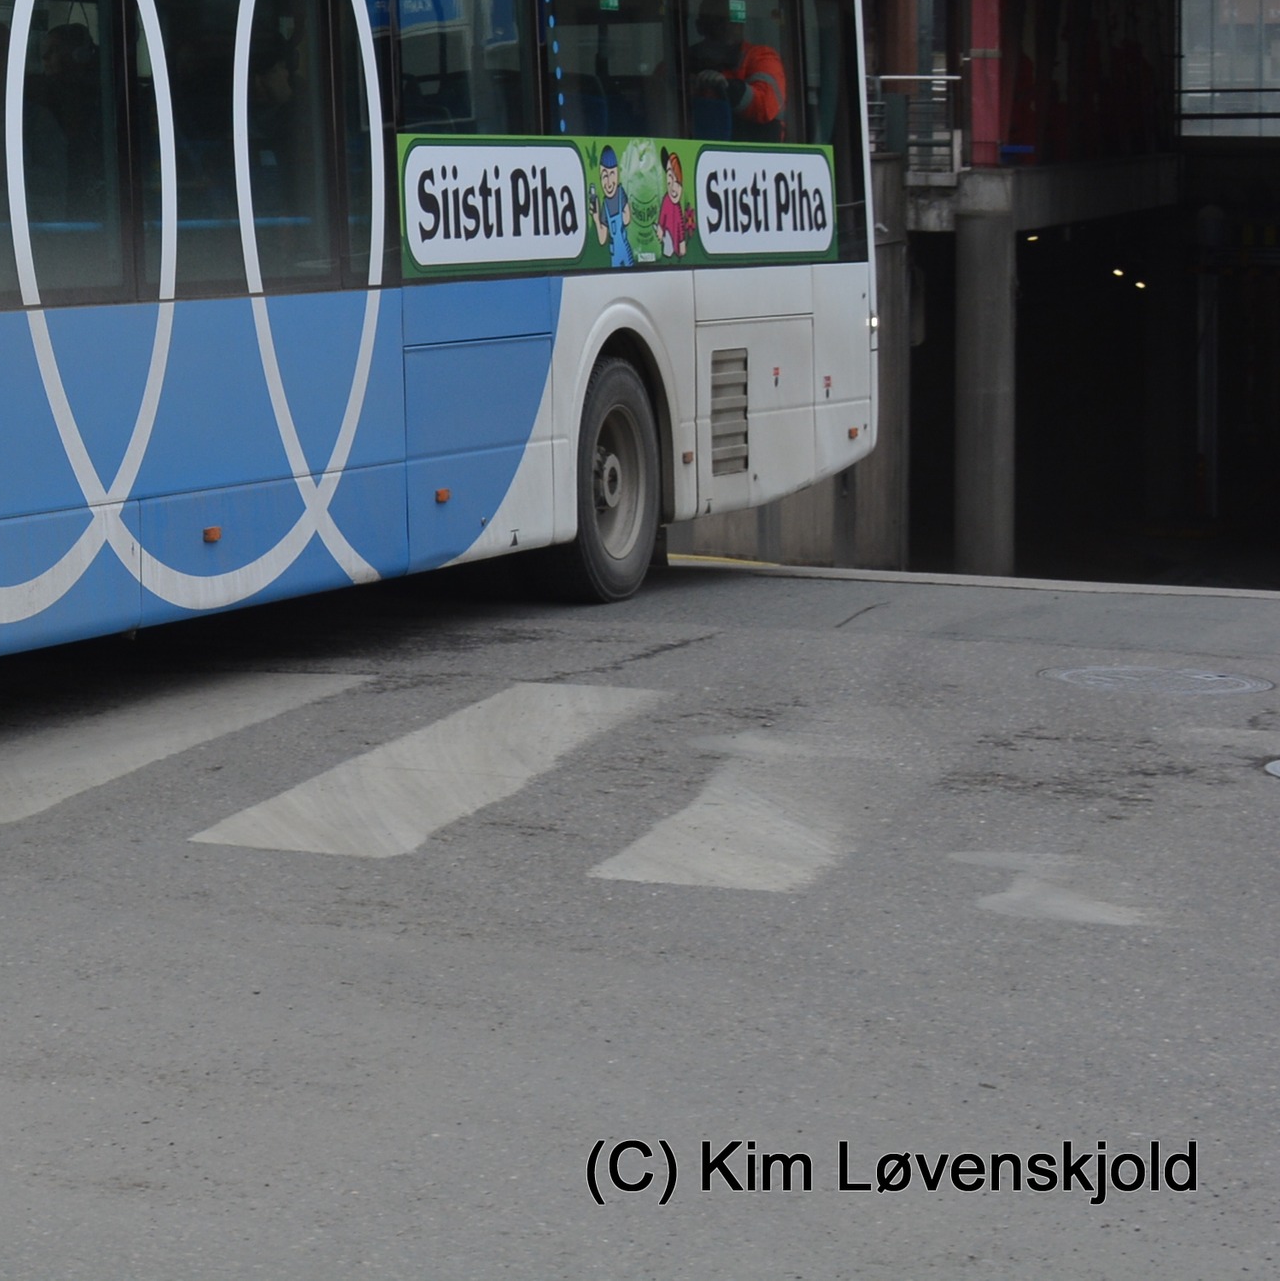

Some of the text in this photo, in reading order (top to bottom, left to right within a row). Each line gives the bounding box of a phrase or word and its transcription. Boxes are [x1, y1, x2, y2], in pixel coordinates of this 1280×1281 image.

[417, 165, 579, 243] Siisti Piha
[705, 168, 828, 235] Siisti Piha
